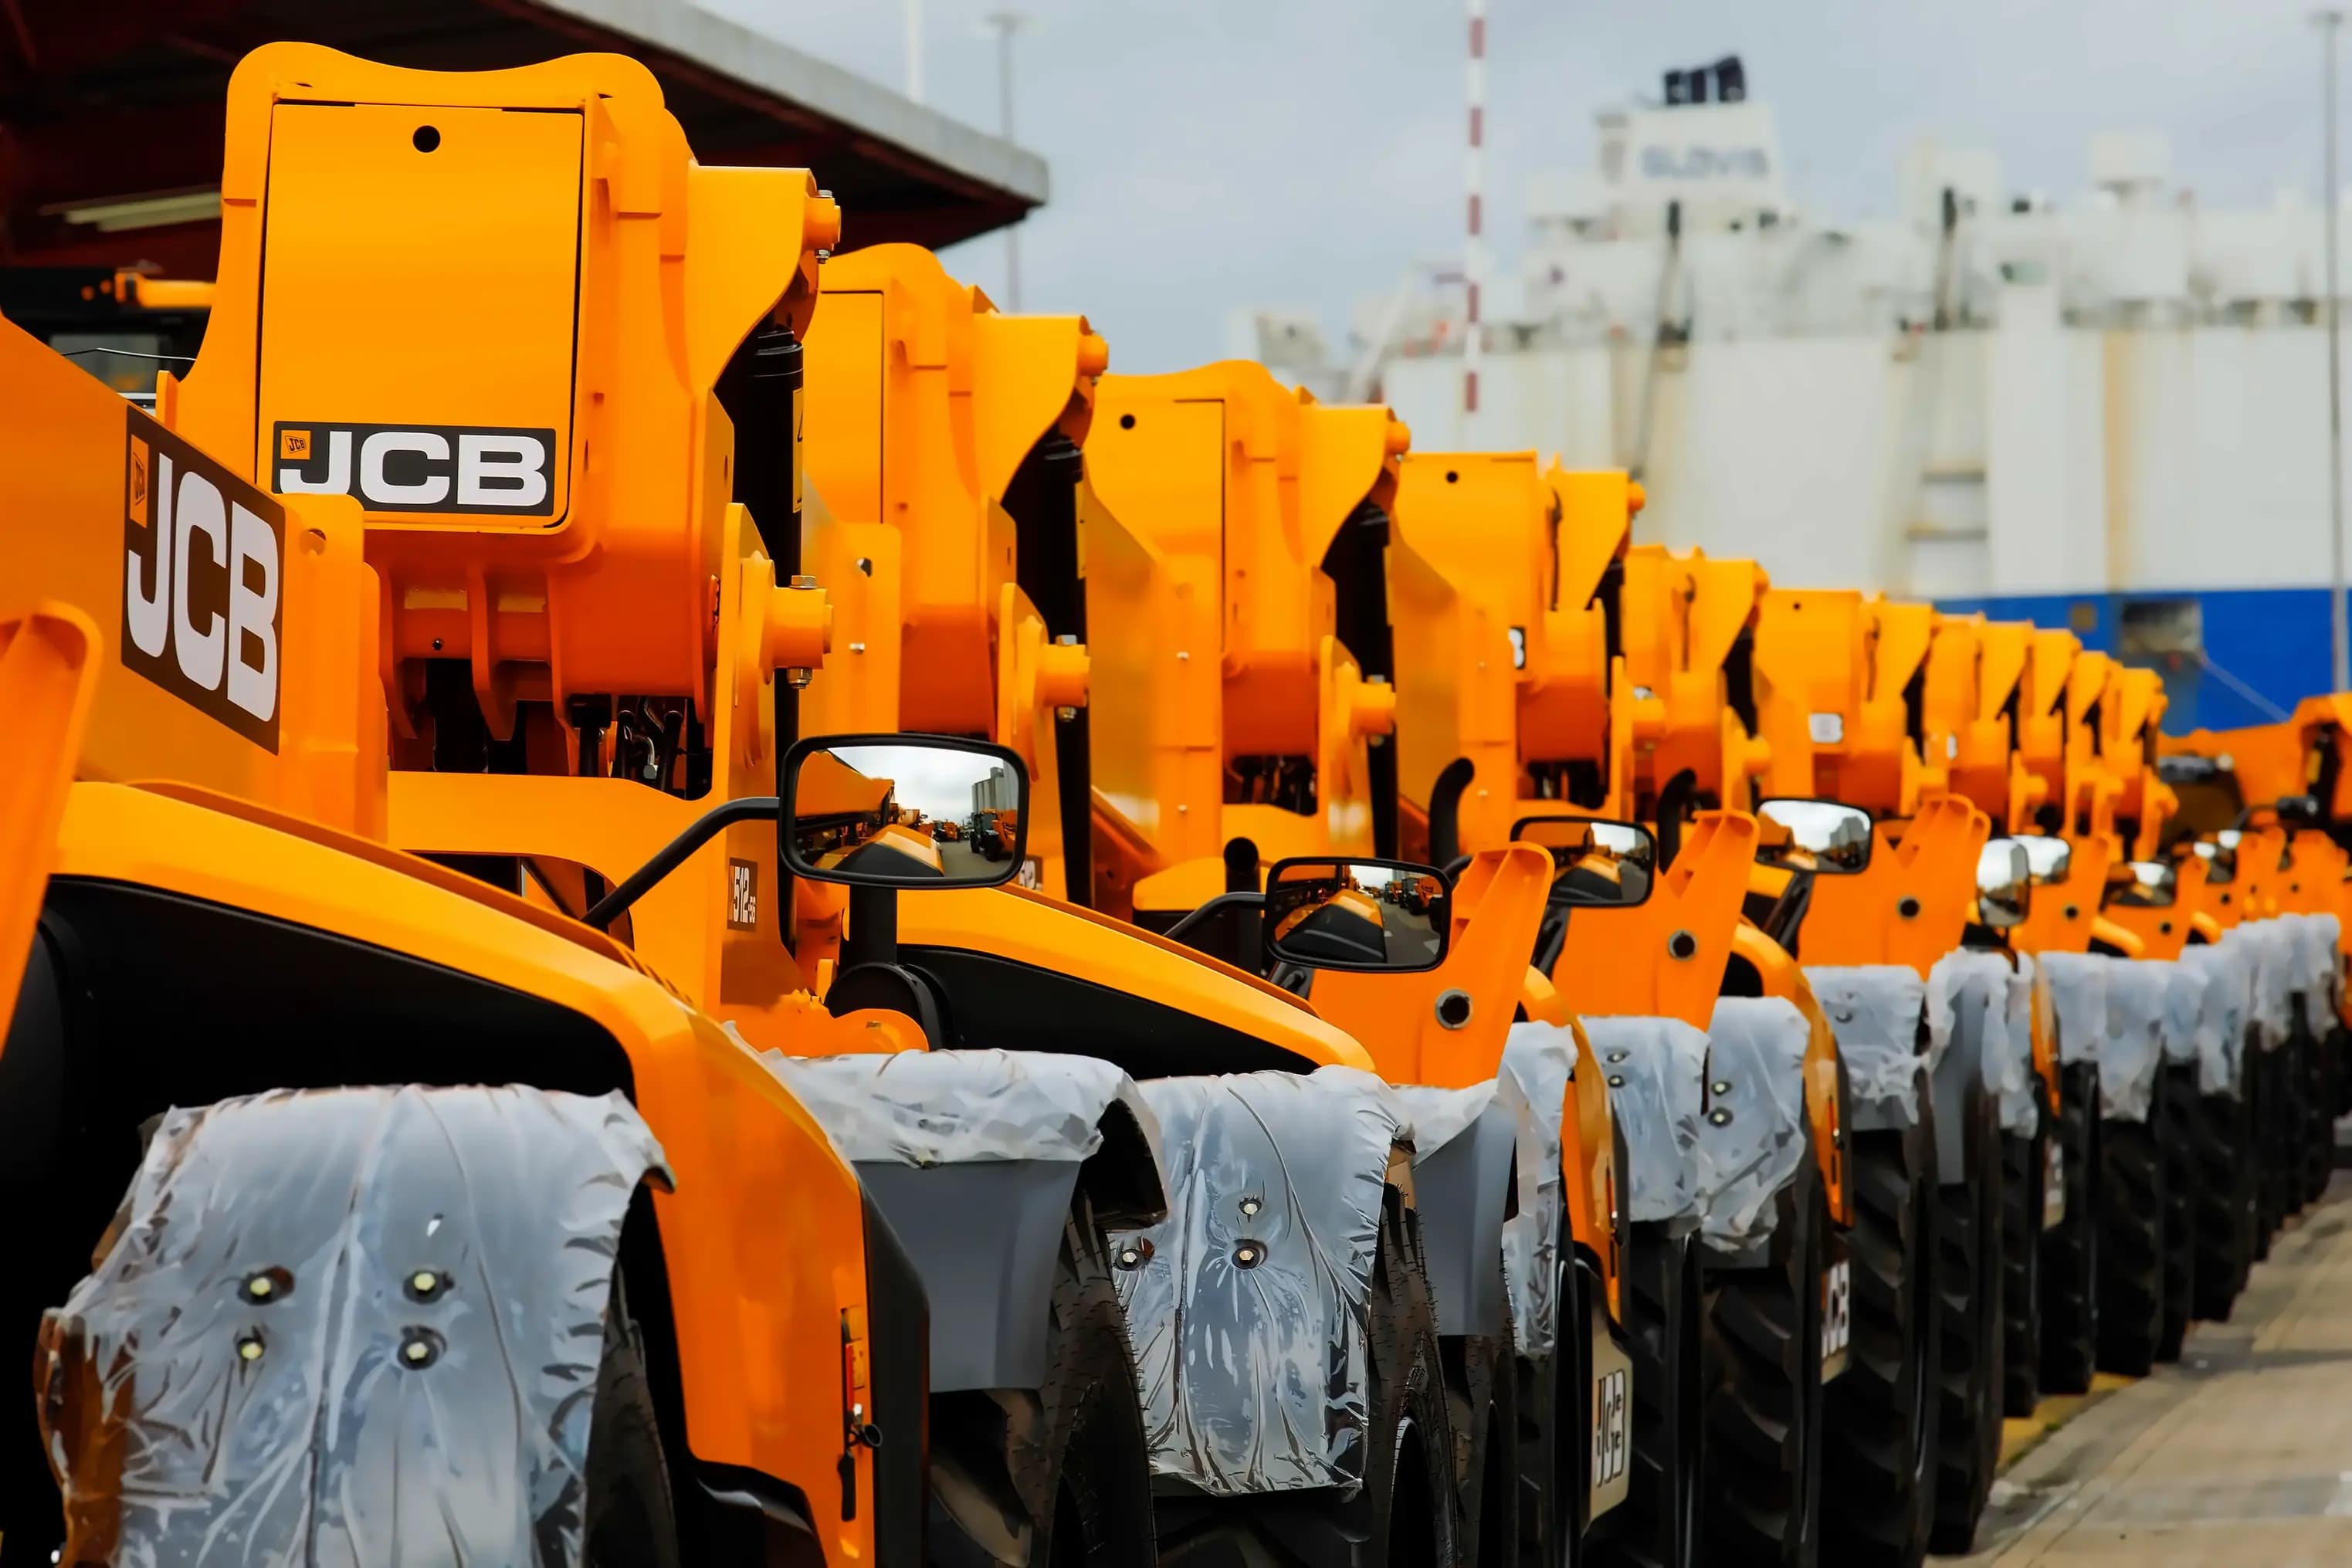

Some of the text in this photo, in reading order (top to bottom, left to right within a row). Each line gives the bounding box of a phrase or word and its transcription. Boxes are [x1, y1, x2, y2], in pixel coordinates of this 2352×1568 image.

[280, 431, 547, 506] JCB
[289, 438, 305, 451] JCB
[127, 453, 279, 723] JCB
